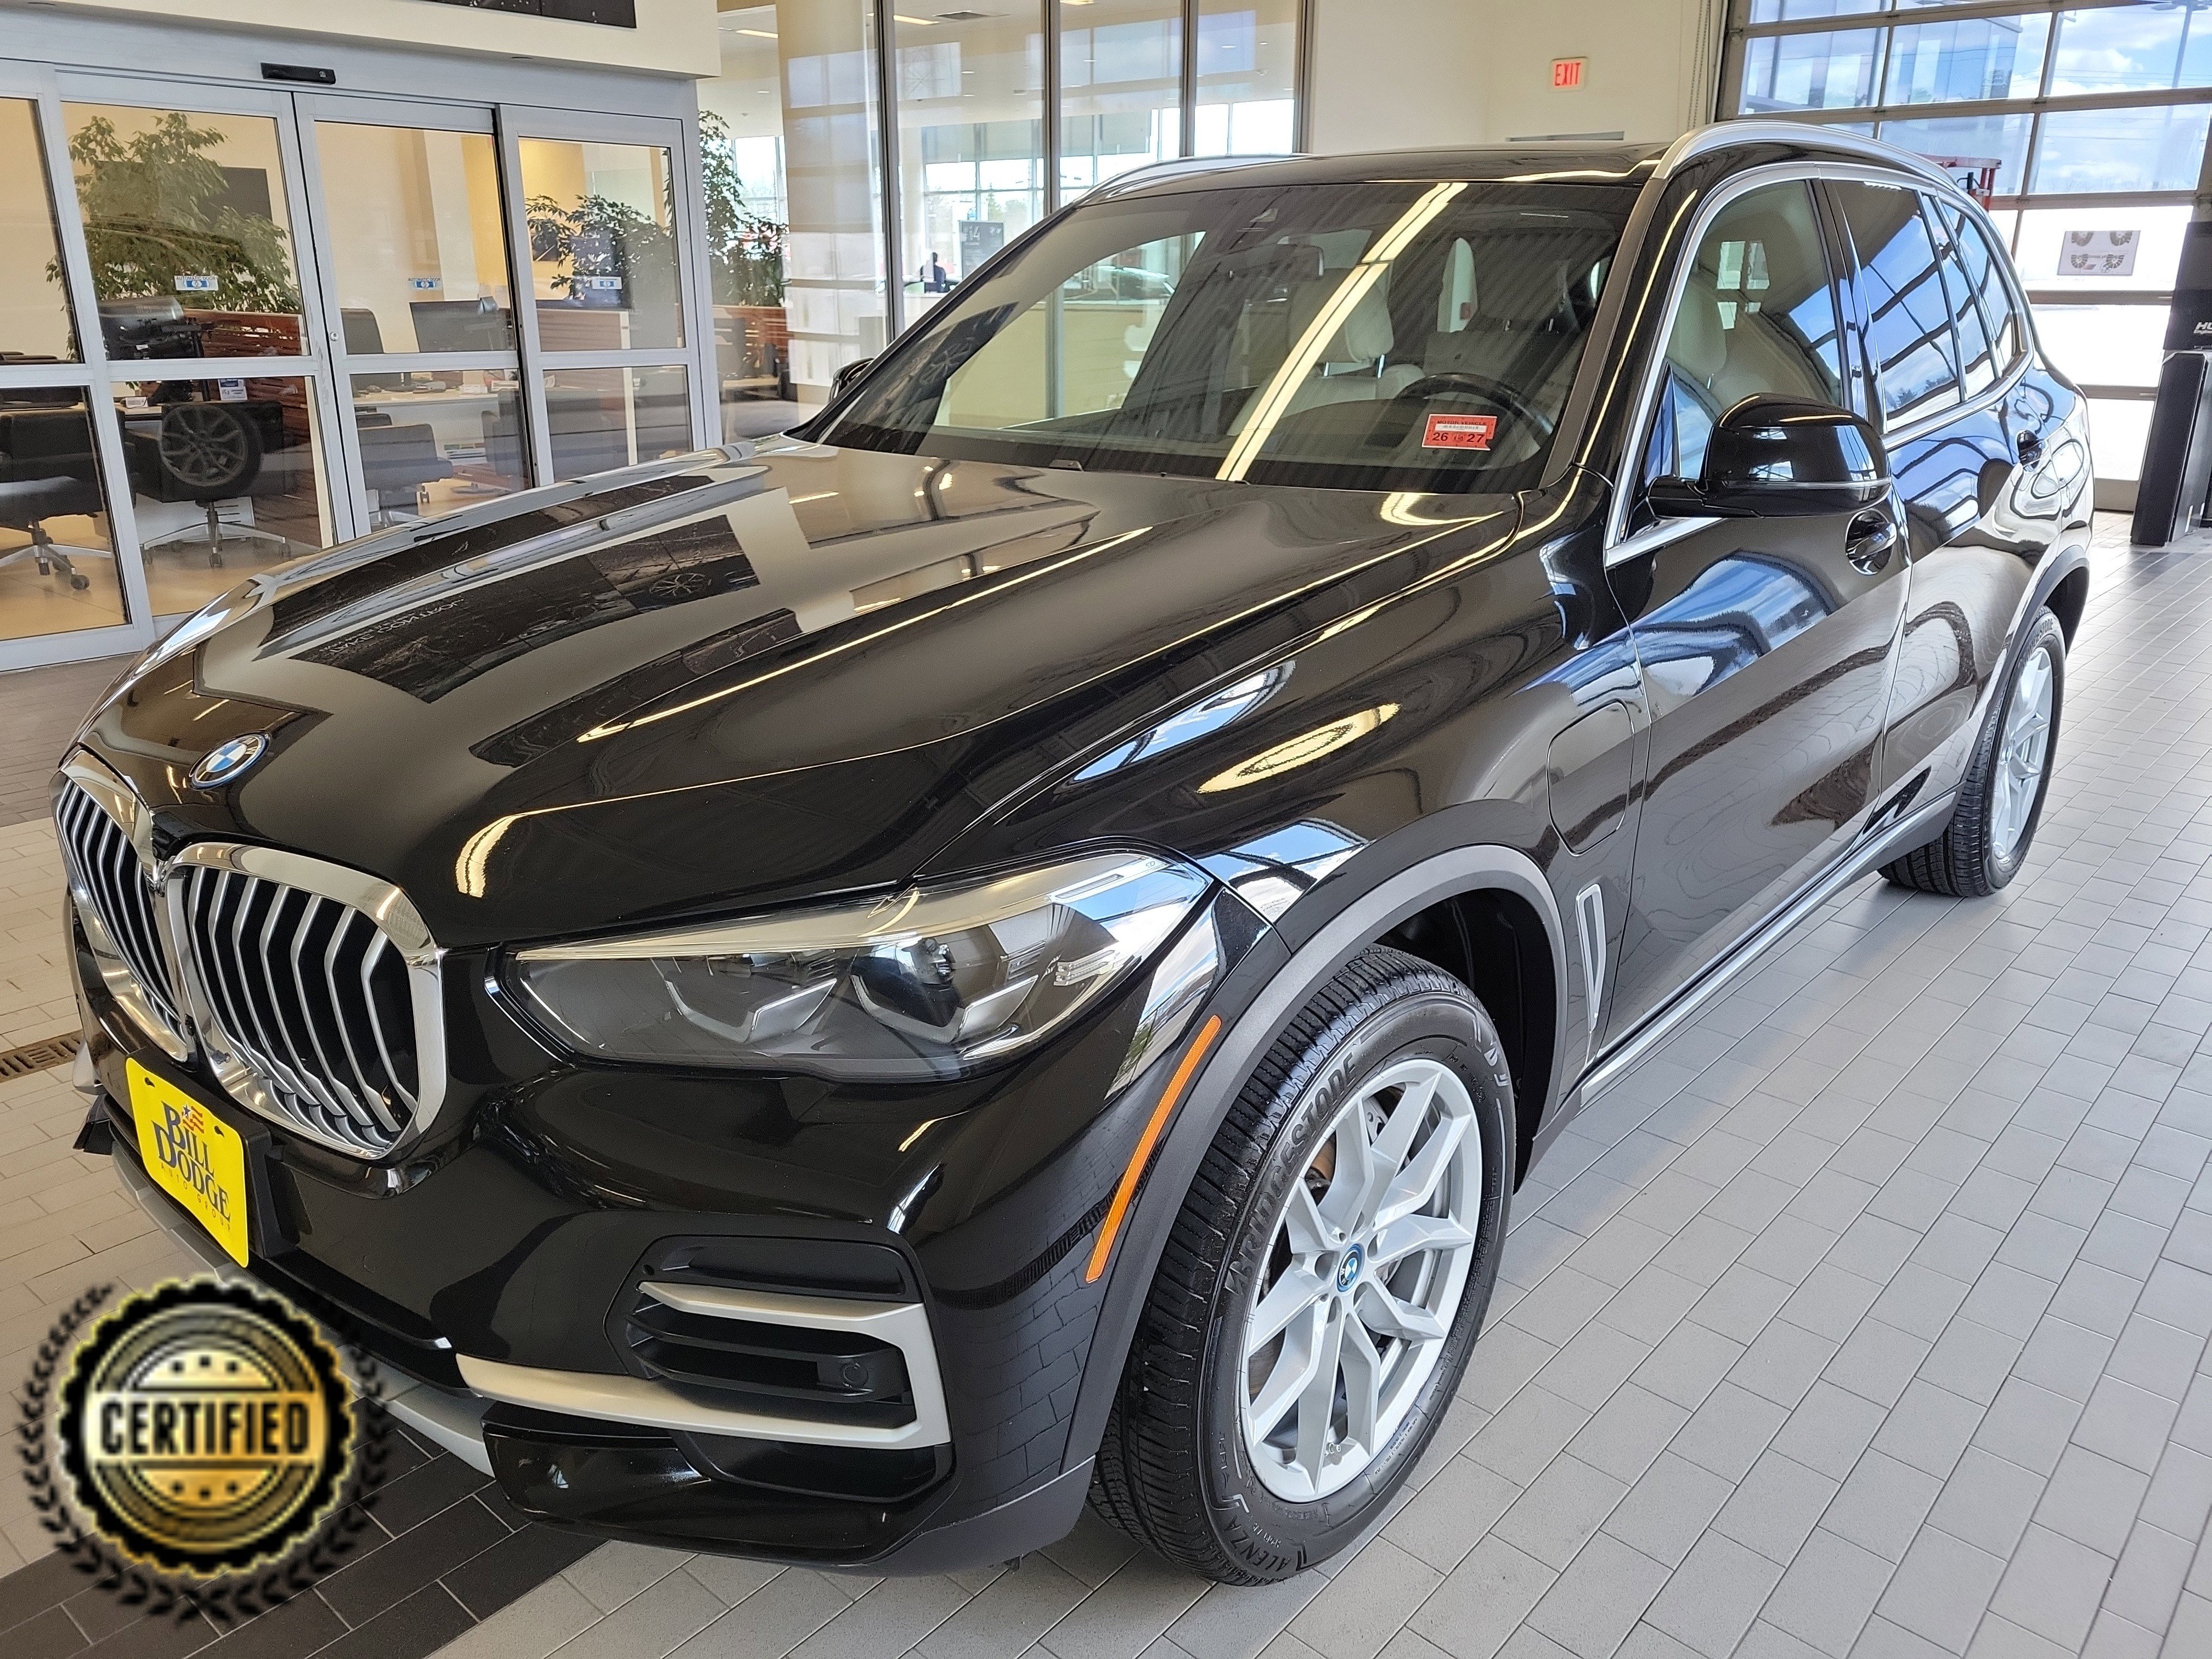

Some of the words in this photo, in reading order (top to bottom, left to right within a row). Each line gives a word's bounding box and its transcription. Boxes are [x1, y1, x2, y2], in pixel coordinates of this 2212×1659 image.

[1555, 63, 1581, 86] EXIT
[1432, 432, 1449, 442] 26
[1466, 433, 1485, 443] 27
[151, 1120, 232, 1224] DODGE
[161, 1101, 215, 1178] BILL
[1225, 1052, 1358, 1295] BRIDGESTONE
[160, 1164, 188, 1191] AUTO
[196, 1193, 232, 1232] GROUP
[1224, 1515, 1291, 1572] ALENZA
